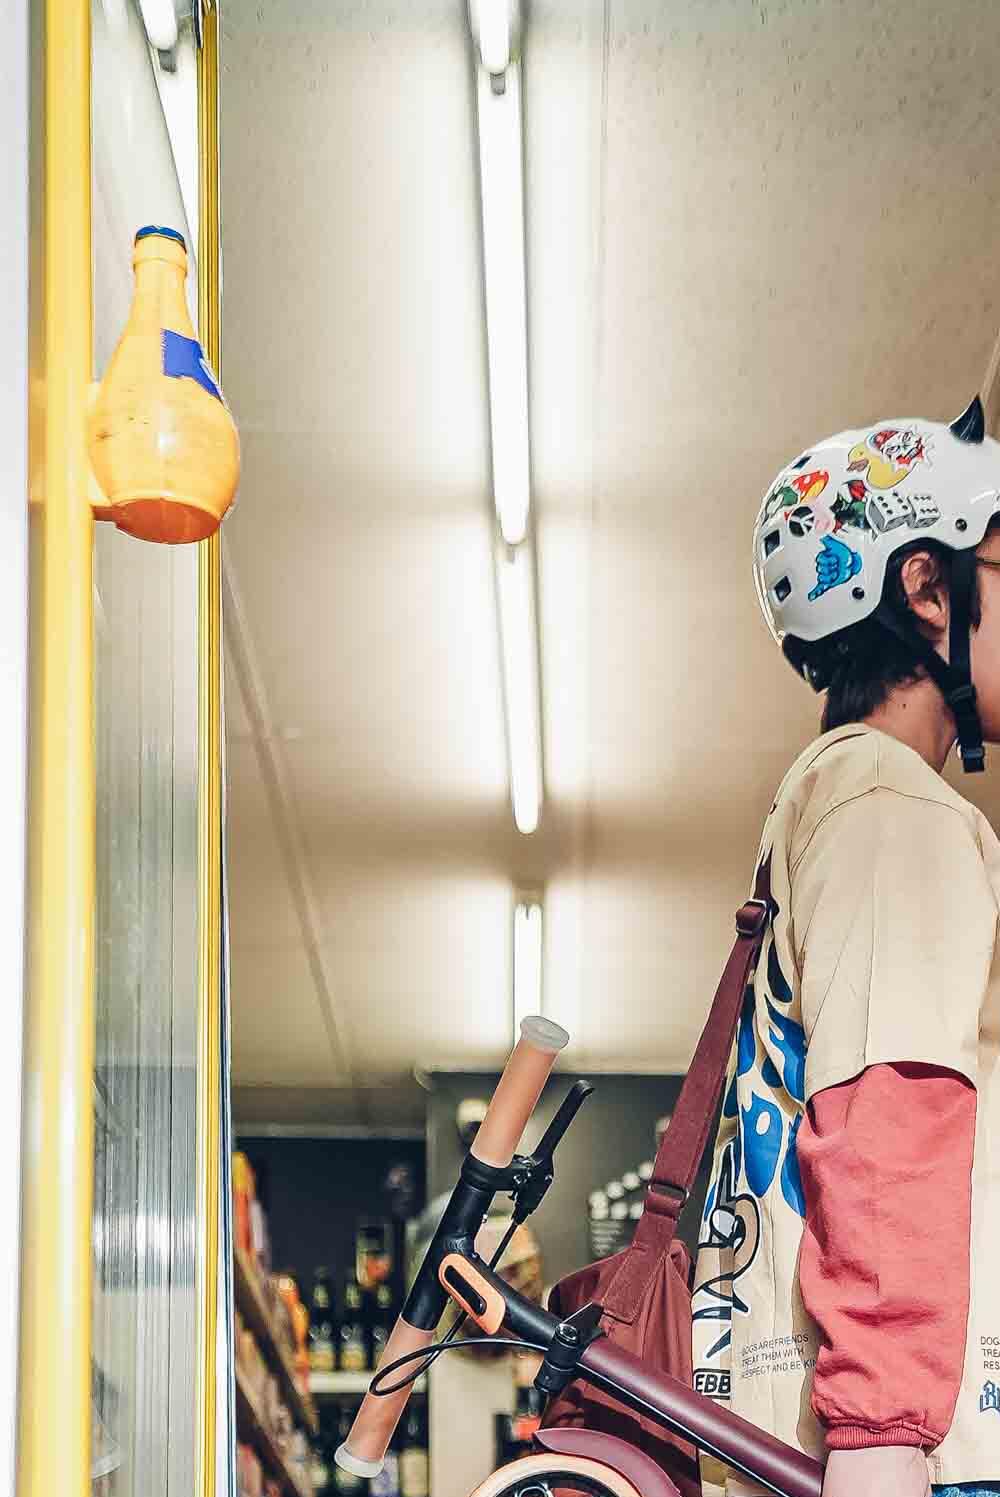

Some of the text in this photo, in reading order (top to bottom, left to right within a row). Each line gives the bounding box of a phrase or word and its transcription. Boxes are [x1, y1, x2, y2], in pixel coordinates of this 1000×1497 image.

[760, 1340, 774, 1350] ARE
[775, 1334, 809, 1346] FRIENDS
[761, 1351, 781, 1361] THEM
[782, 1347, 804, 1358] WITH
[772, 1362, 788, 1373] AND
[790, 1360, 801, 1370] BE
[803, 1359, 817, 1369] KIN
